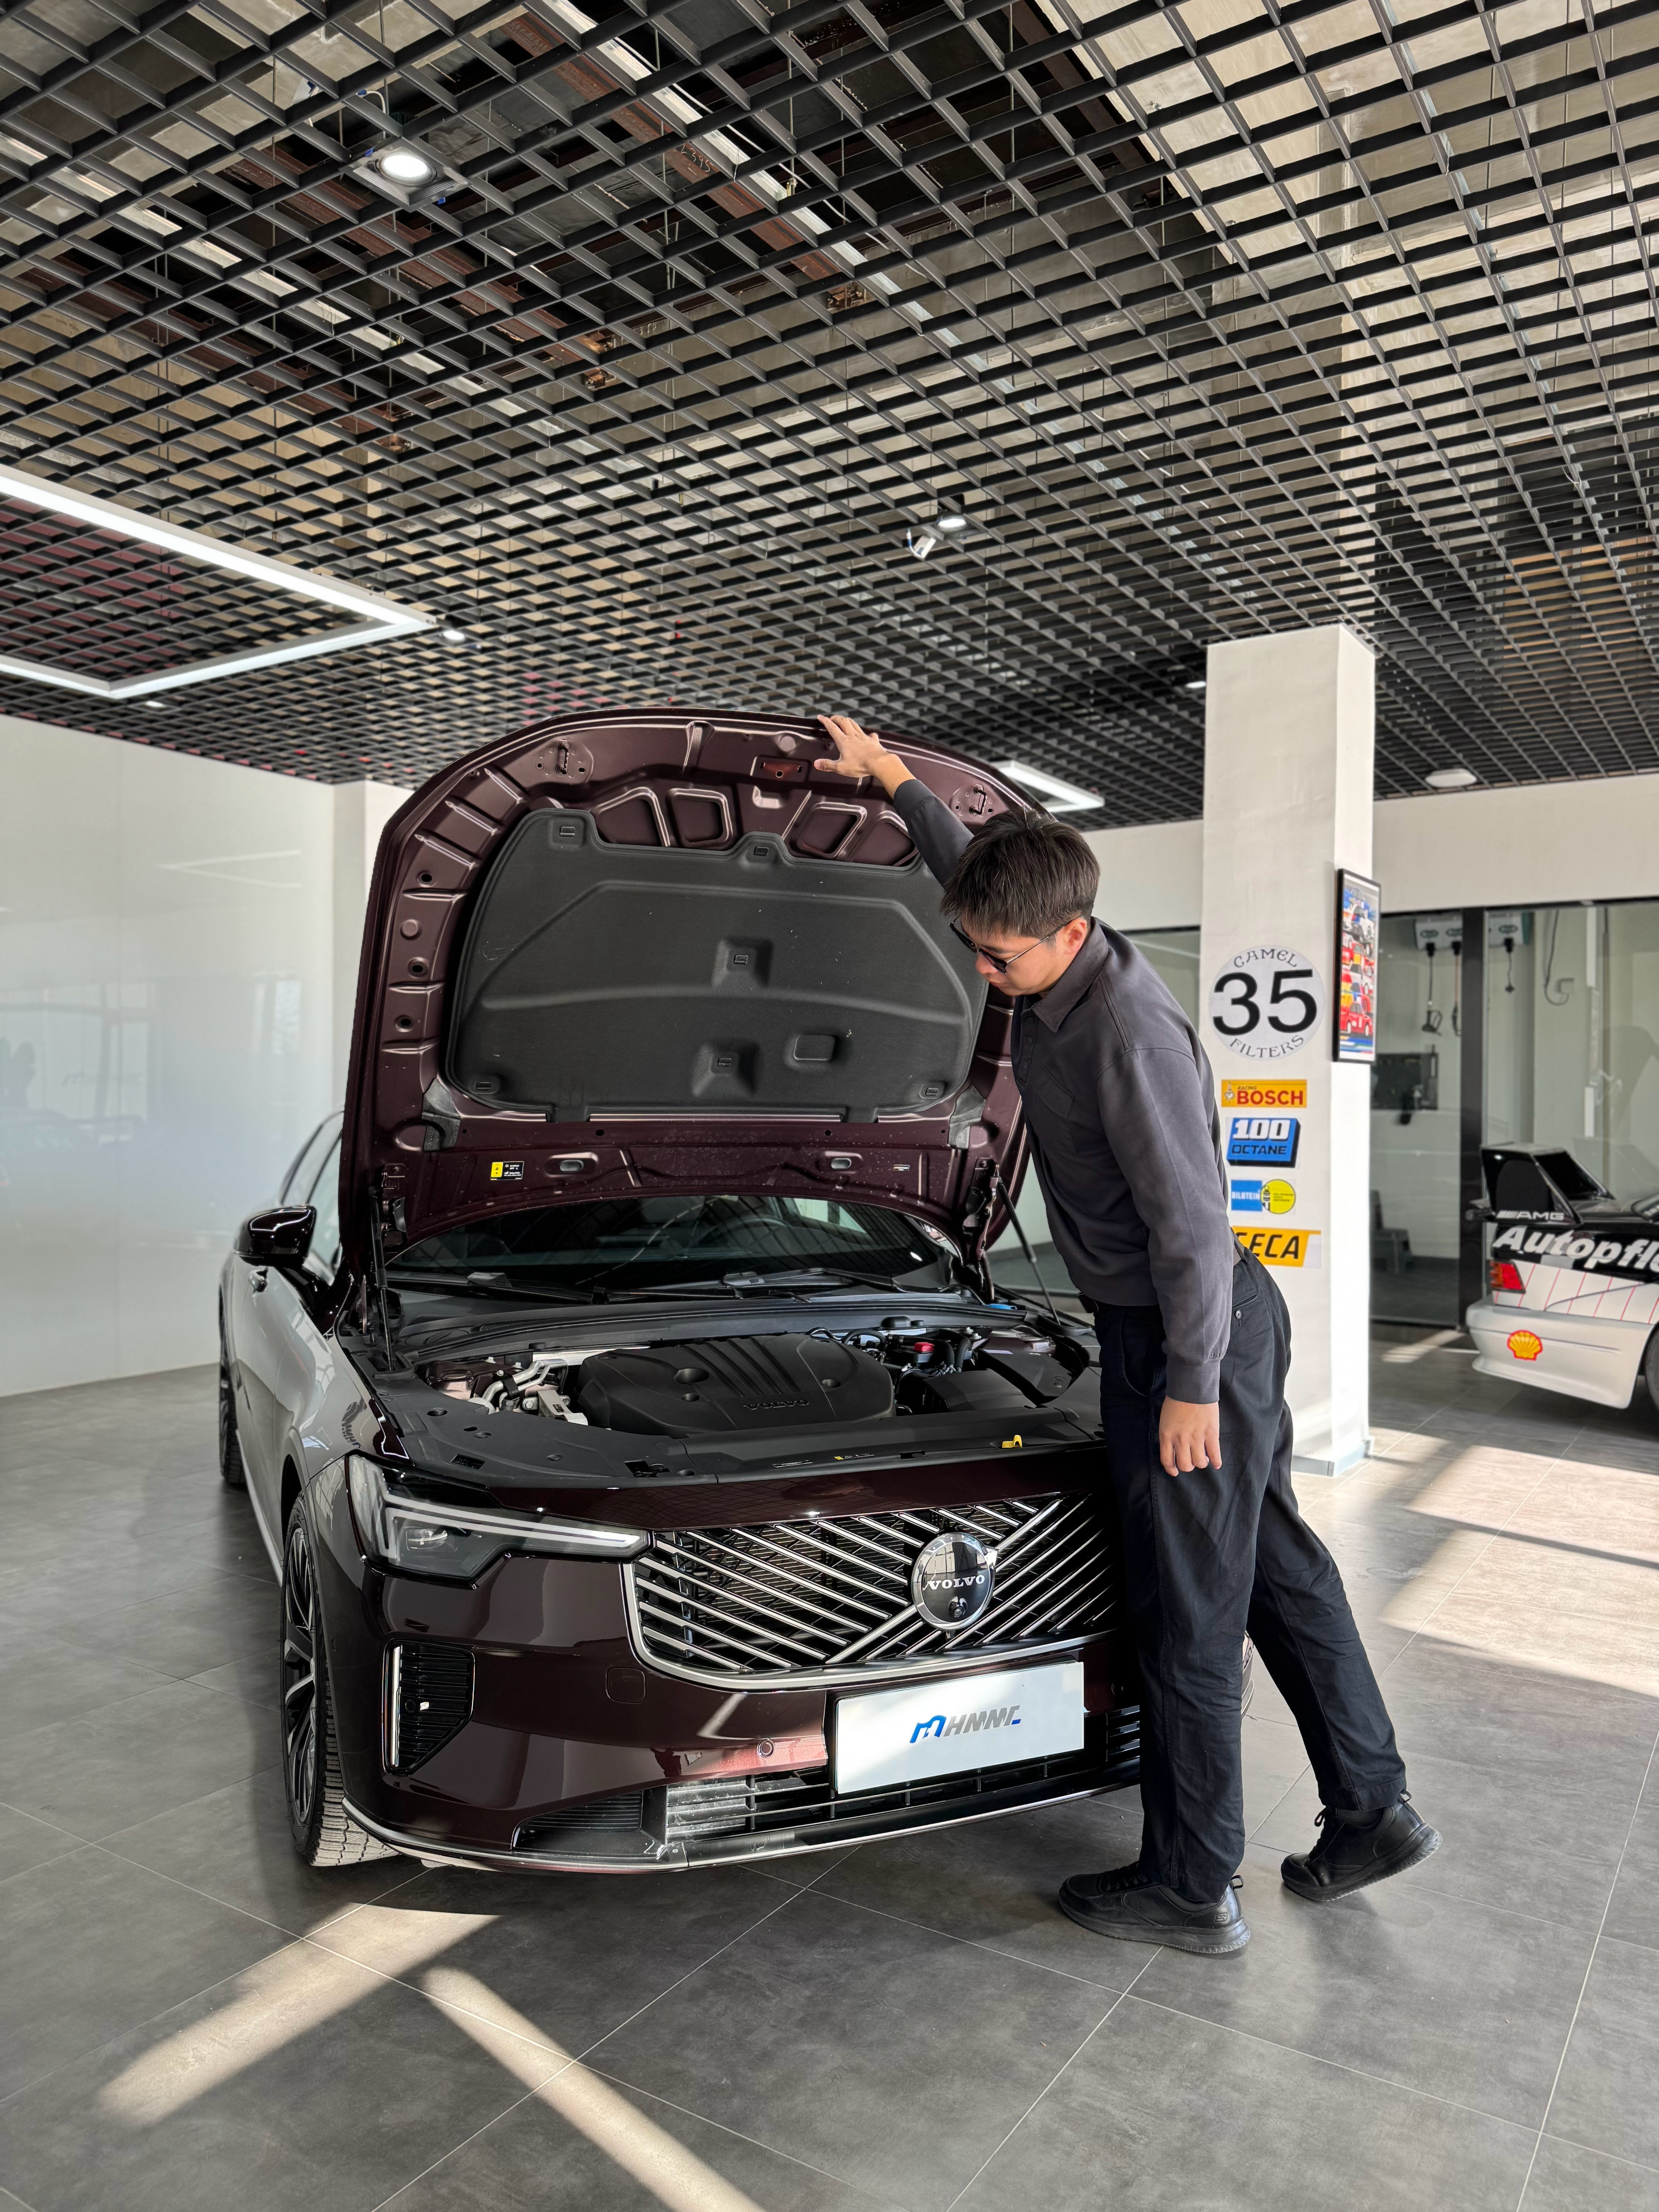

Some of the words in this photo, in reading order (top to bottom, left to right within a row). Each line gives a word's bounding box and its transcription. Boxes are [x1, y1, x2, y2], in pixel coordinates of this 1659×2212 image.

[1233, 948, 1297, 968] CAMEL
[1212, 969, 1317, 1036] 35
[1229, 1035, 1304, 1058] FILTERS
[1237, 1090, 1304, 1105] BOSCH
[1233, 1119, 1291, 1140] 100
[1231, 1144, 1287, 1155] OCTANE
[1231, 1192, 1260, 1200] BILSTEIN
[1515, 1211, 1565, 1221] AMG
[743, 1400, 809, 1410] VOLVO
[927, 1575, 985, 1590] VOLVO
